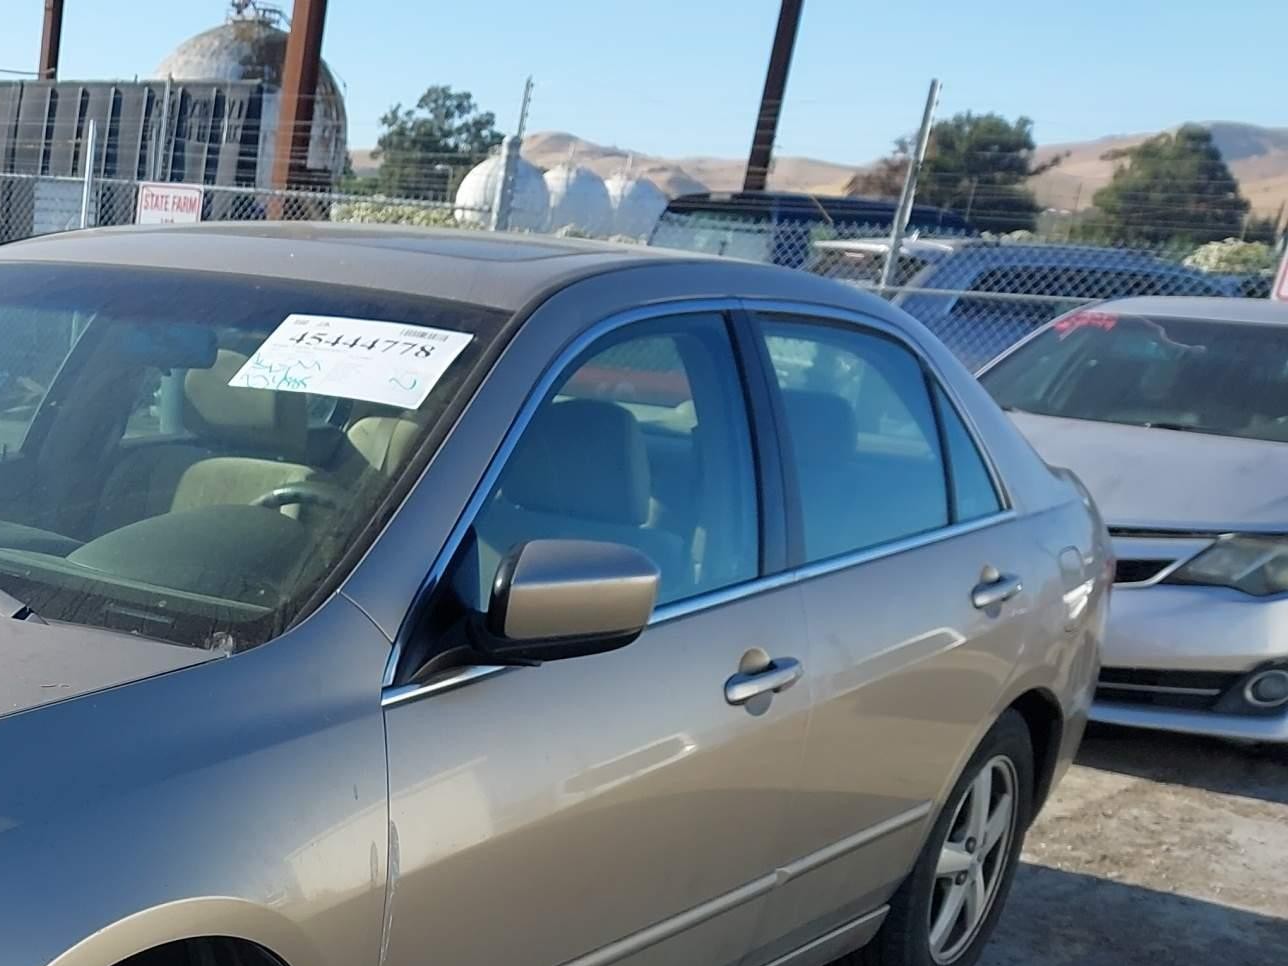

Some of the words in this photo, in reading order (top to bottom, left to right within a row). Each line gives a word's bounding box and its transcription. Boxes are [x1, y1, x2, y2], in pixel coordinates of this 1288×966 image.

[143, 191, 169, 212] STATE
[172, 195, 200, 214] FARM
[289, 331, 435, 358] 45444778
